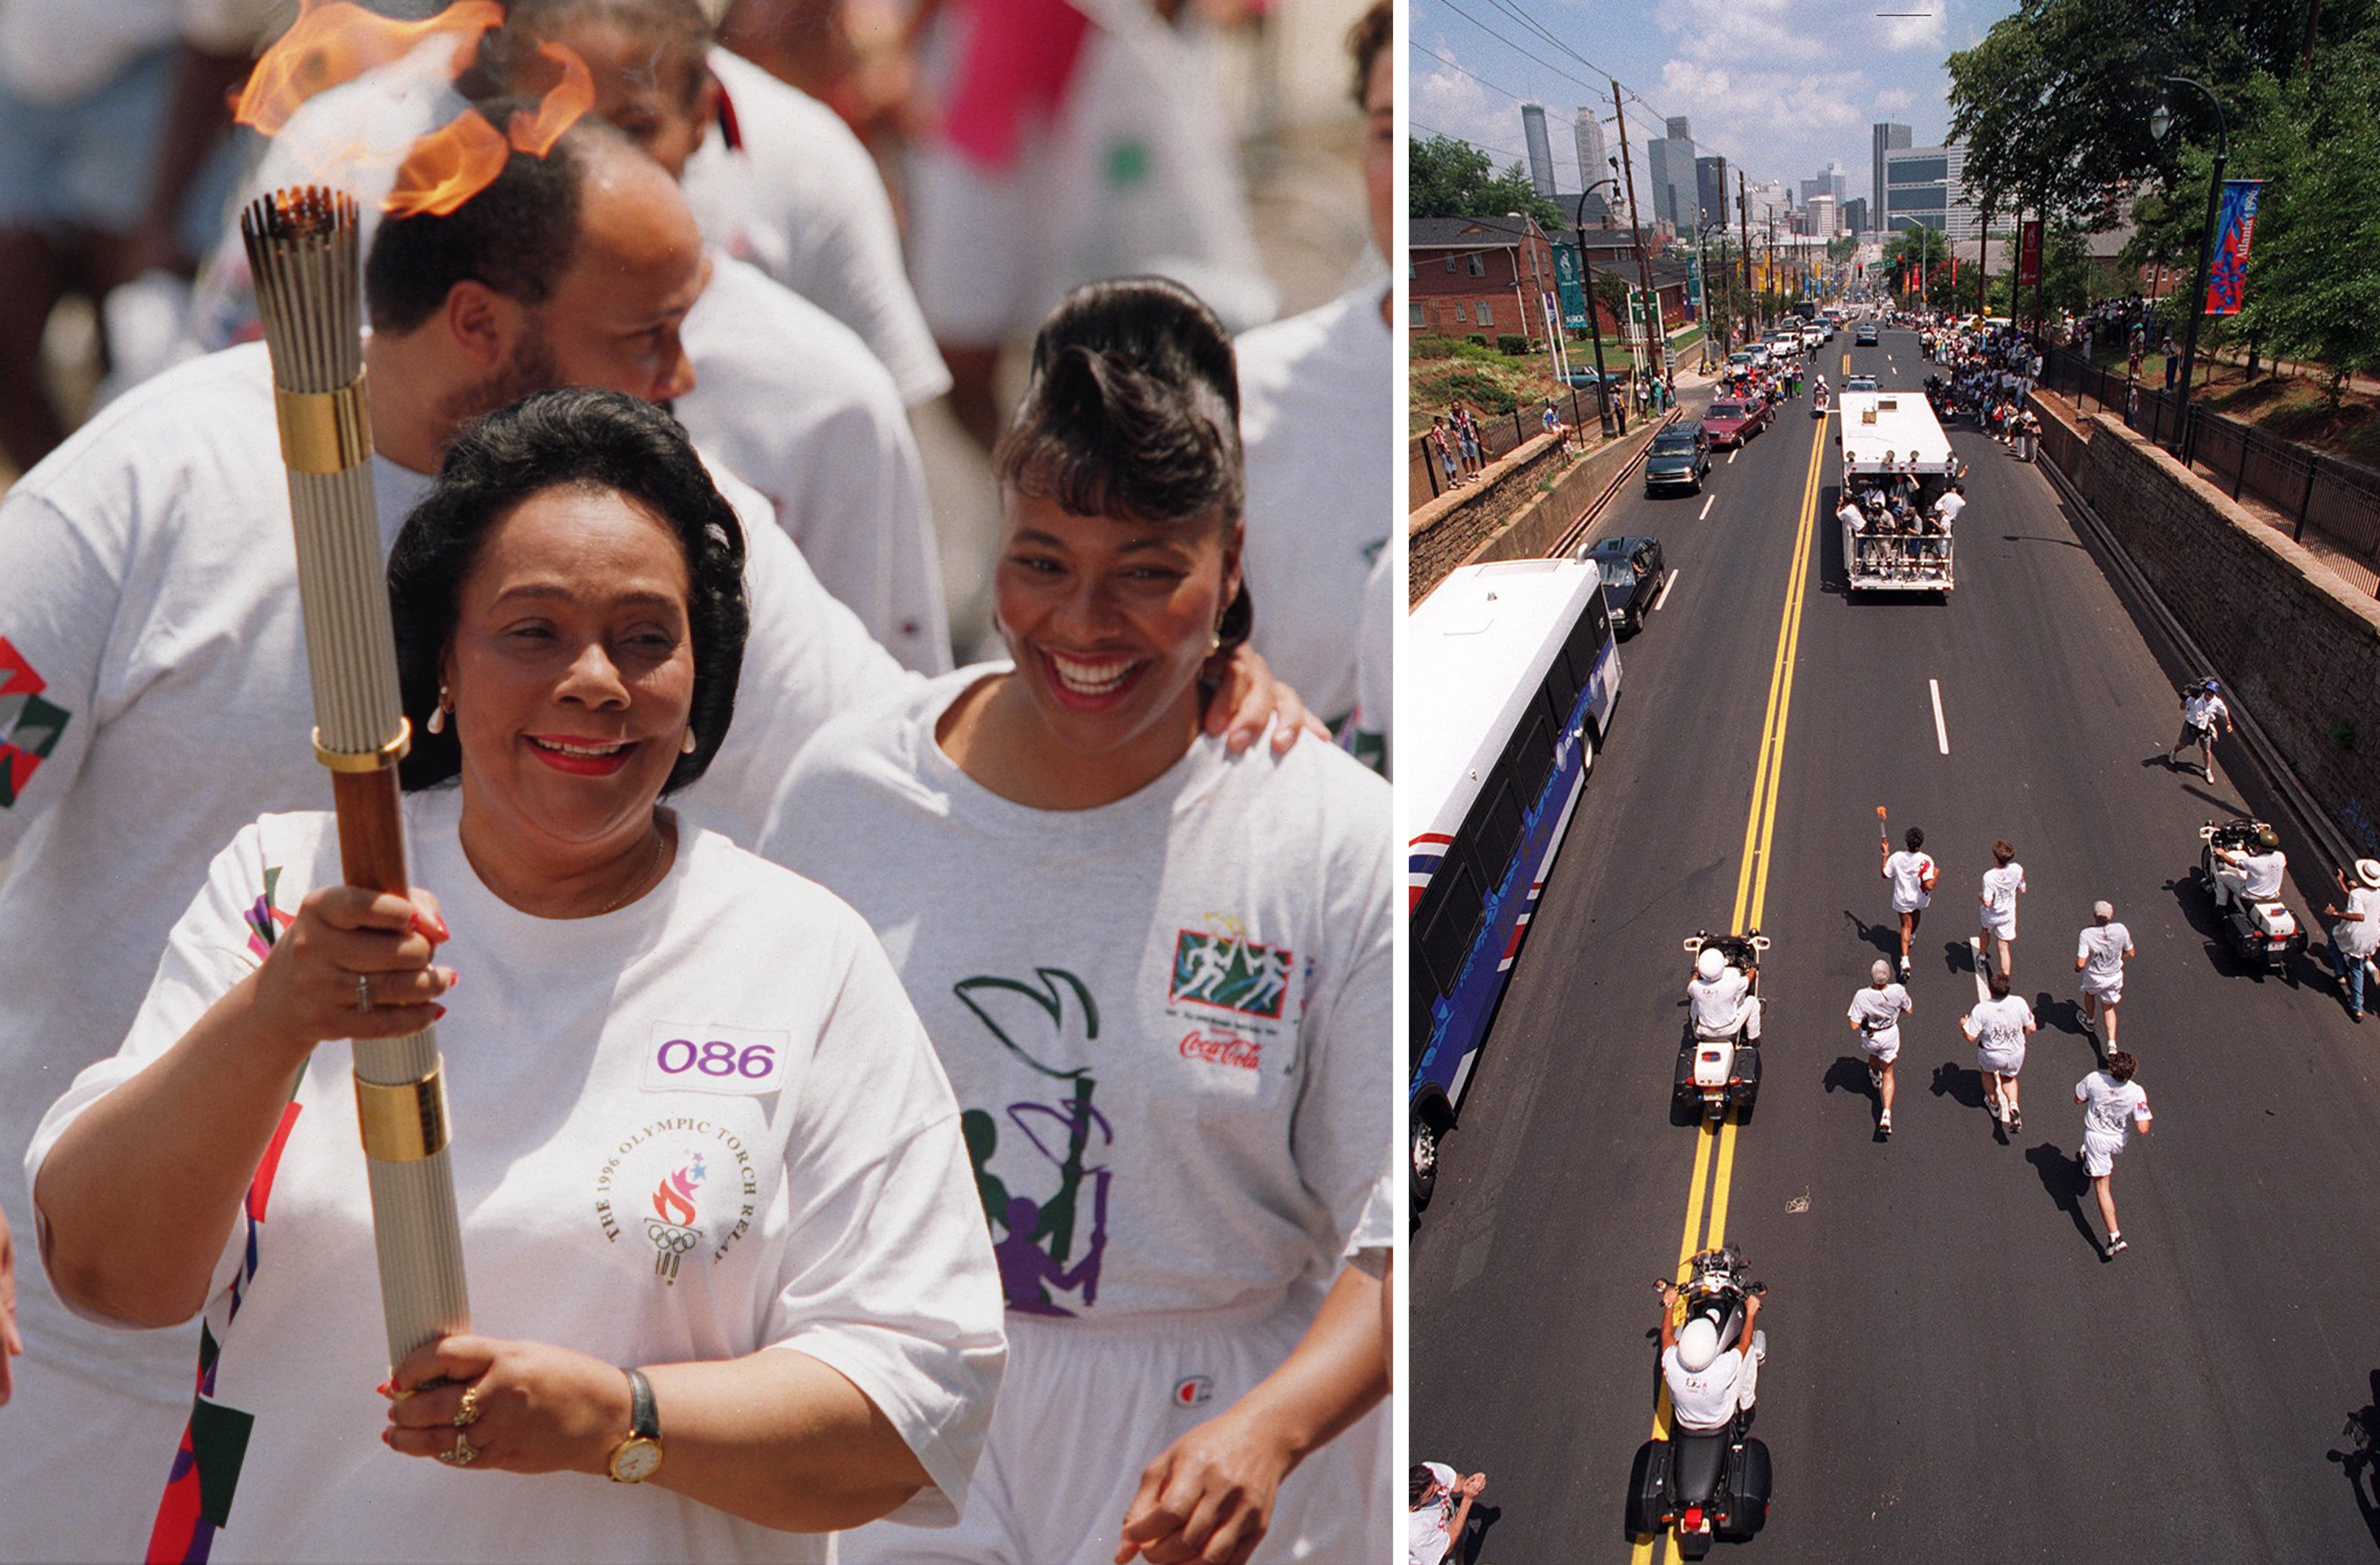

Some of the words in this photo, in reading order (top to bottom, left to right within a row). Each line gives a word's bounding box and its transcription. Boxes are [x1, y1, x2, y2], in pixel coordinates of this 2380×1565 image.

[2236, 219, 2254, 259] Atlanta
[657, 1039, 775, 1078] 086
[619, 1118, 711, 1154] OLYMPIC
[597, 1157, 620, 1192] 1996
[716, 1127, 757, 1195] TORCH
[596, 1199, 620, 1243] THE
[714, 1204, 755, 1266] RELAY
